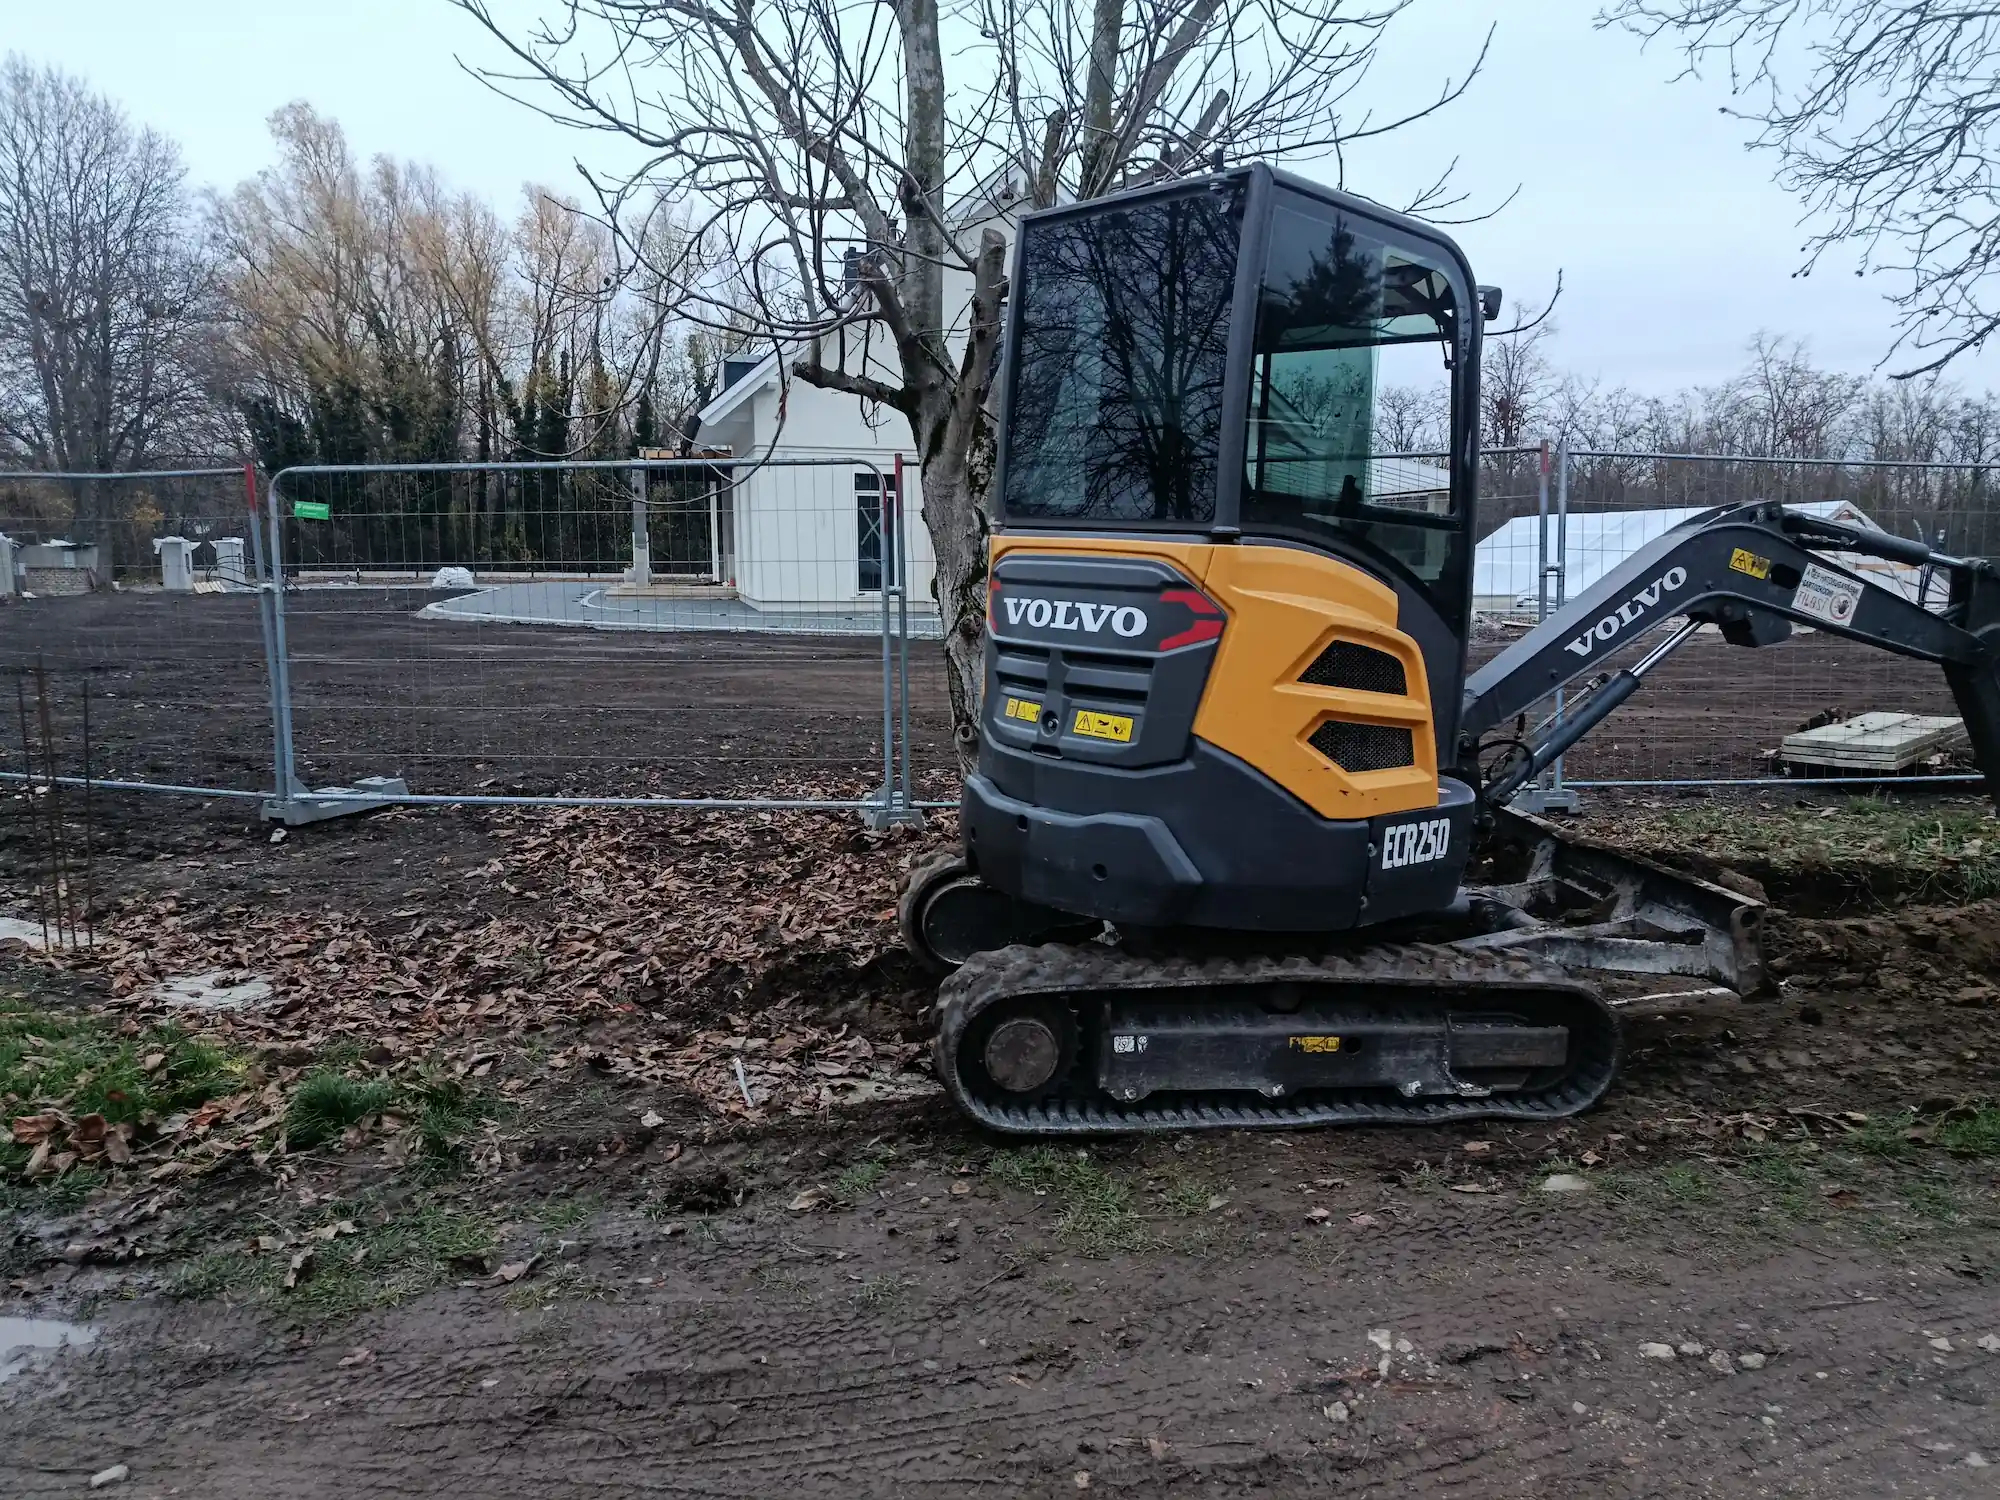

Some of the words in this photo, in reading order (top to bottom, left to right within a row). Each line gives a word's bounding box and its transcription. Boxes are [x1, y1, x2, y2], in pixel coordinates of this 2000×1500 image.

[1003, 597, 1148, 637] VOLVO
[1564, 566, 1687, 657] VOLVO
[1381, 818, 1450, 870] ECR25D
